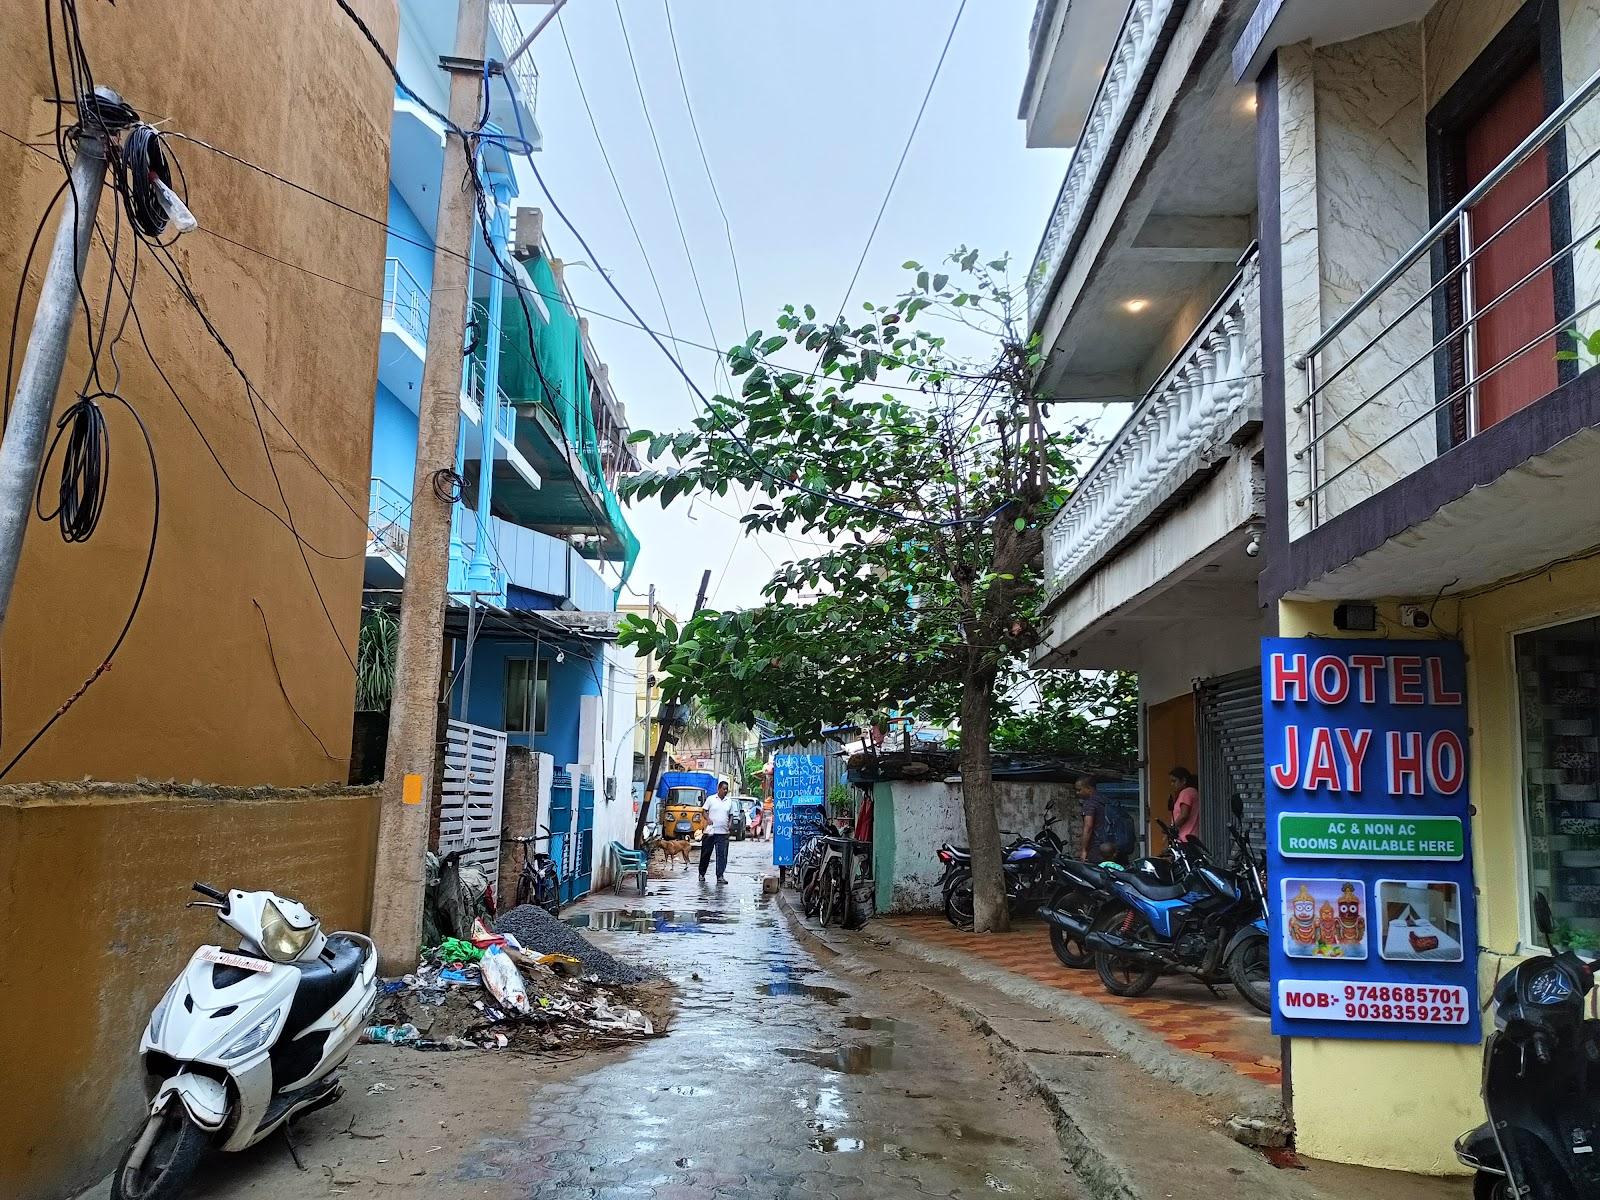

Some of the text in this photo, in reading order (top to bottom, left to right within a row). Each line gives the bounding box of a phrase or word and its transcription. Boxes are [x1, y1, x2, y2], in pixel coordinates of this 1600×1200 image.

[1270, 653, 1462, 705] HOTEL
[1270, 725, 1465, 795] JAY HO
[776, 790, 794, 800] COLD
[1327, 822, 1416, 836] AC & NON AC
[1289, 838, 1455, 852] ROOMS AVAILABLE HERE
[1286, 992, 1339, 1008] MOB:-
[1344, 985, 1461, 1004] 9748685701
[1345, 1003, 1465, 1022] 9038359237
